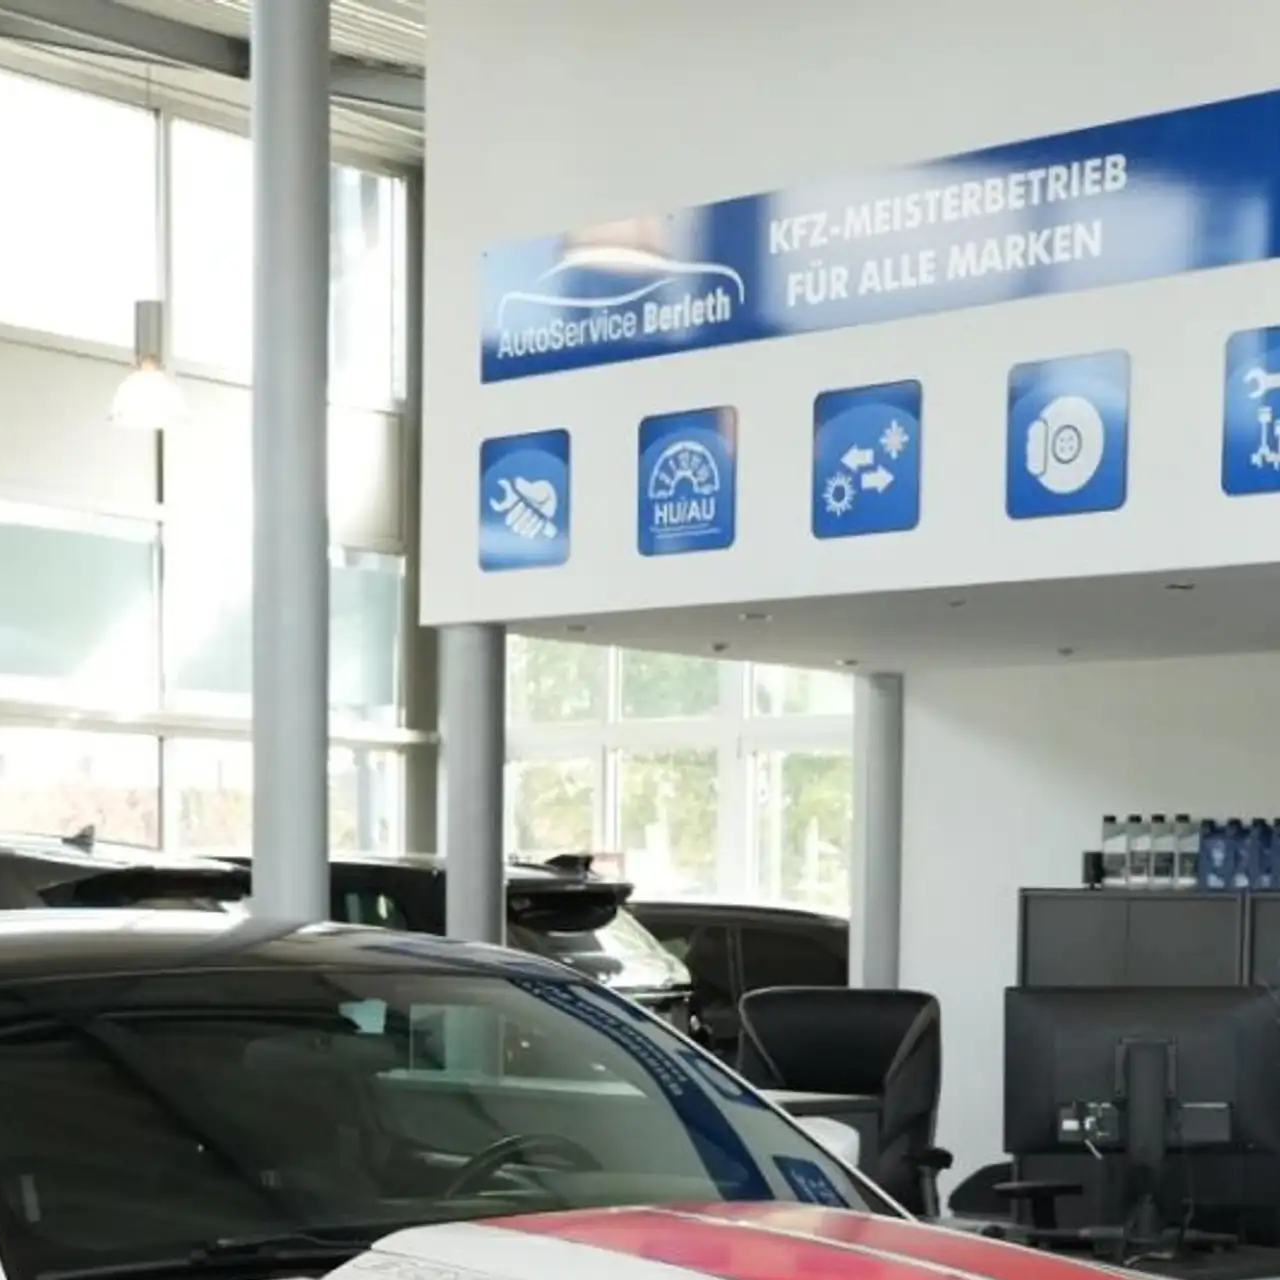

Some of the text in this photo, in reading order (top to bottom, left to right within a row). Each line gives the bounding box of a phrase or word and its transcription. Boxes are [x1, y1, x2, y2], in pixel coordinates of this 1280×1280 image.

[769, 153, 1128, 254] KFZ-MEISTERBETRIEB
[786, 219, 1104, 308] FÜR ALLE MARKEN
[496, 286, 732, 359] AutoService Berleth
